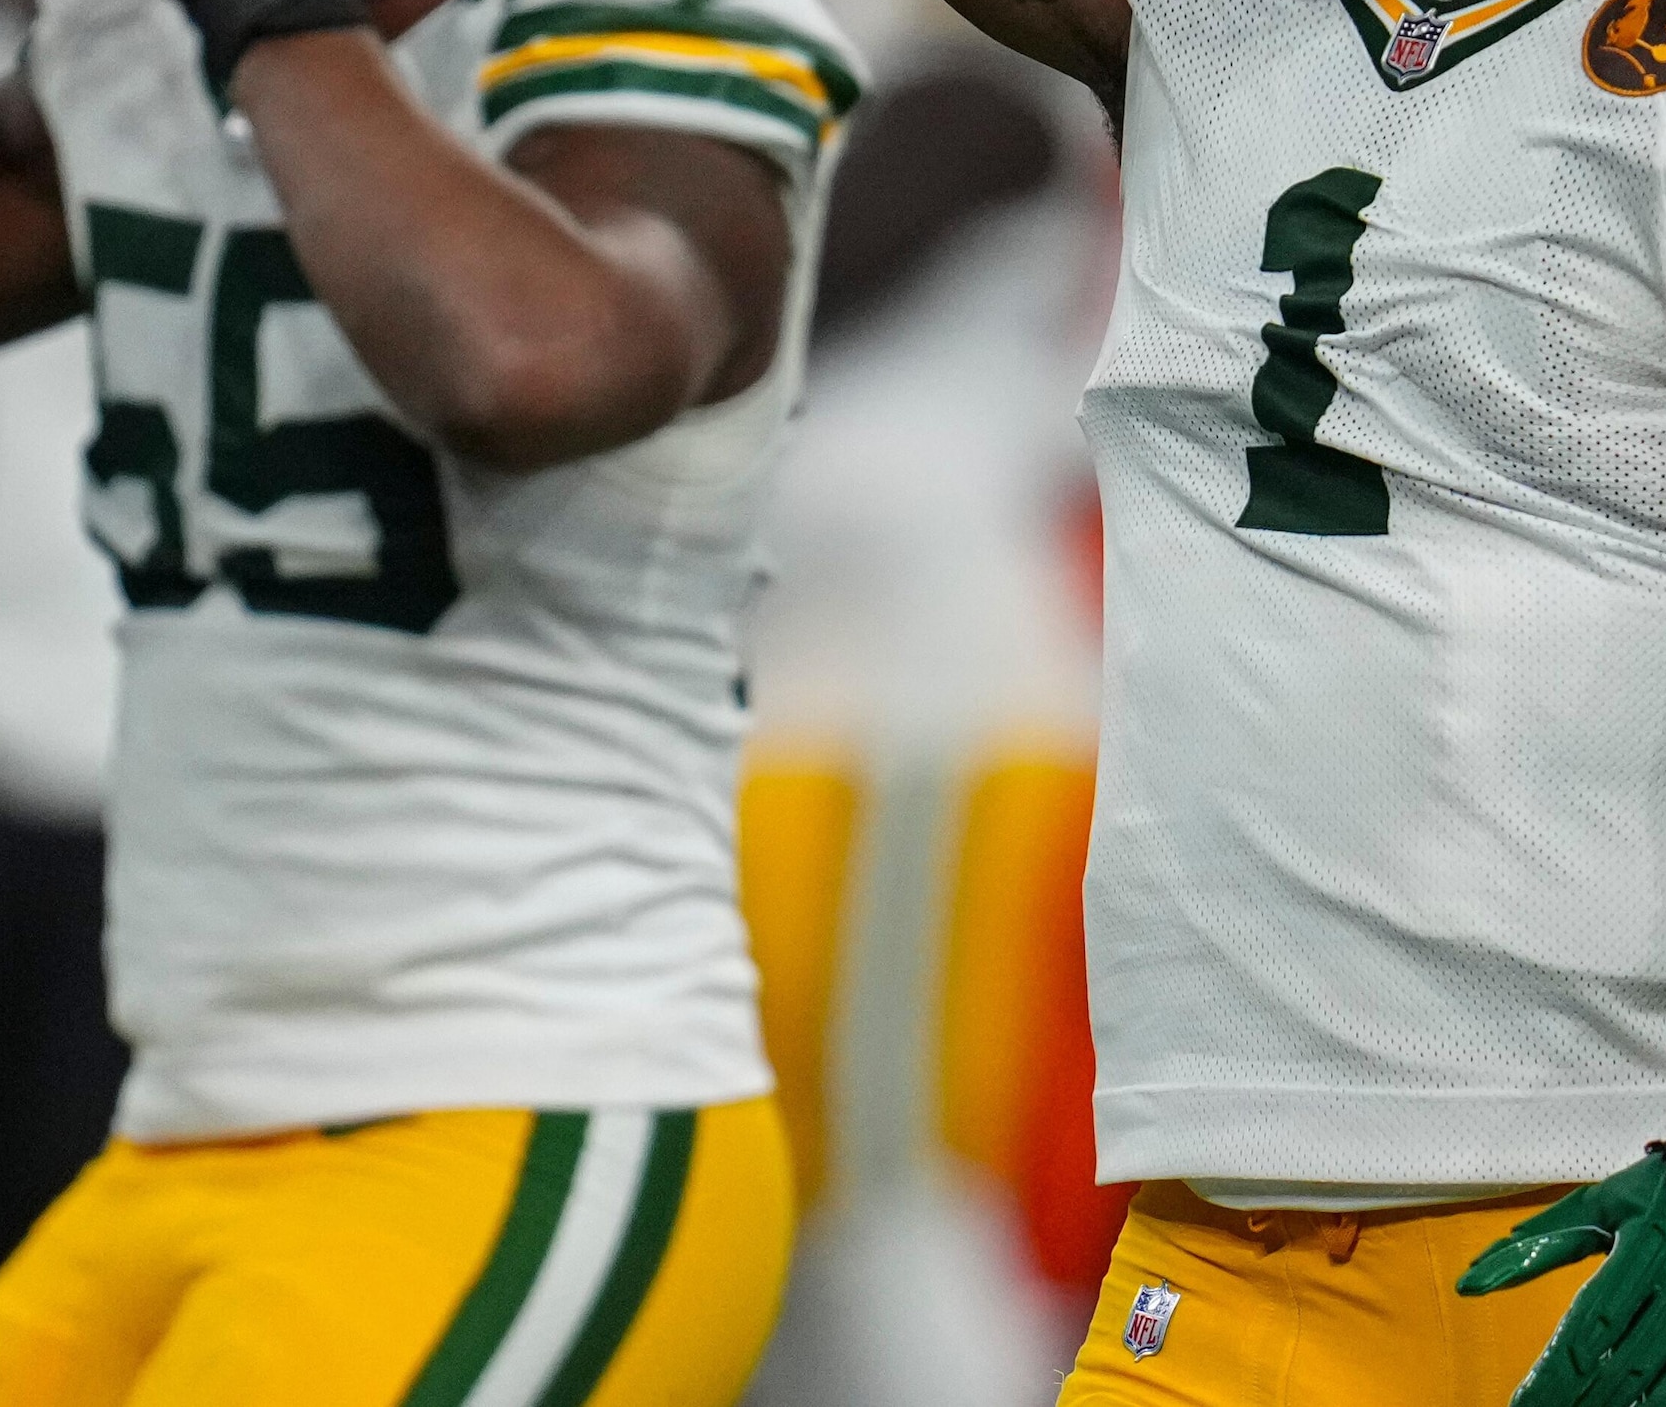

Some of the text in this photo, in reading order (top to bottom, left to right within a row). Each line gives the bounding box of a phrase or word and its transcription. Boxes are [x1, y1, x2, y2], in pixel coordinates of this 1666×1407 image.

[1389, 37, 1429, 70] NFL
[85, 202, 462, 634] 55
[1235, 166, 1389, 535] 1
[1128, 1313, 1158, 1347] NFL
